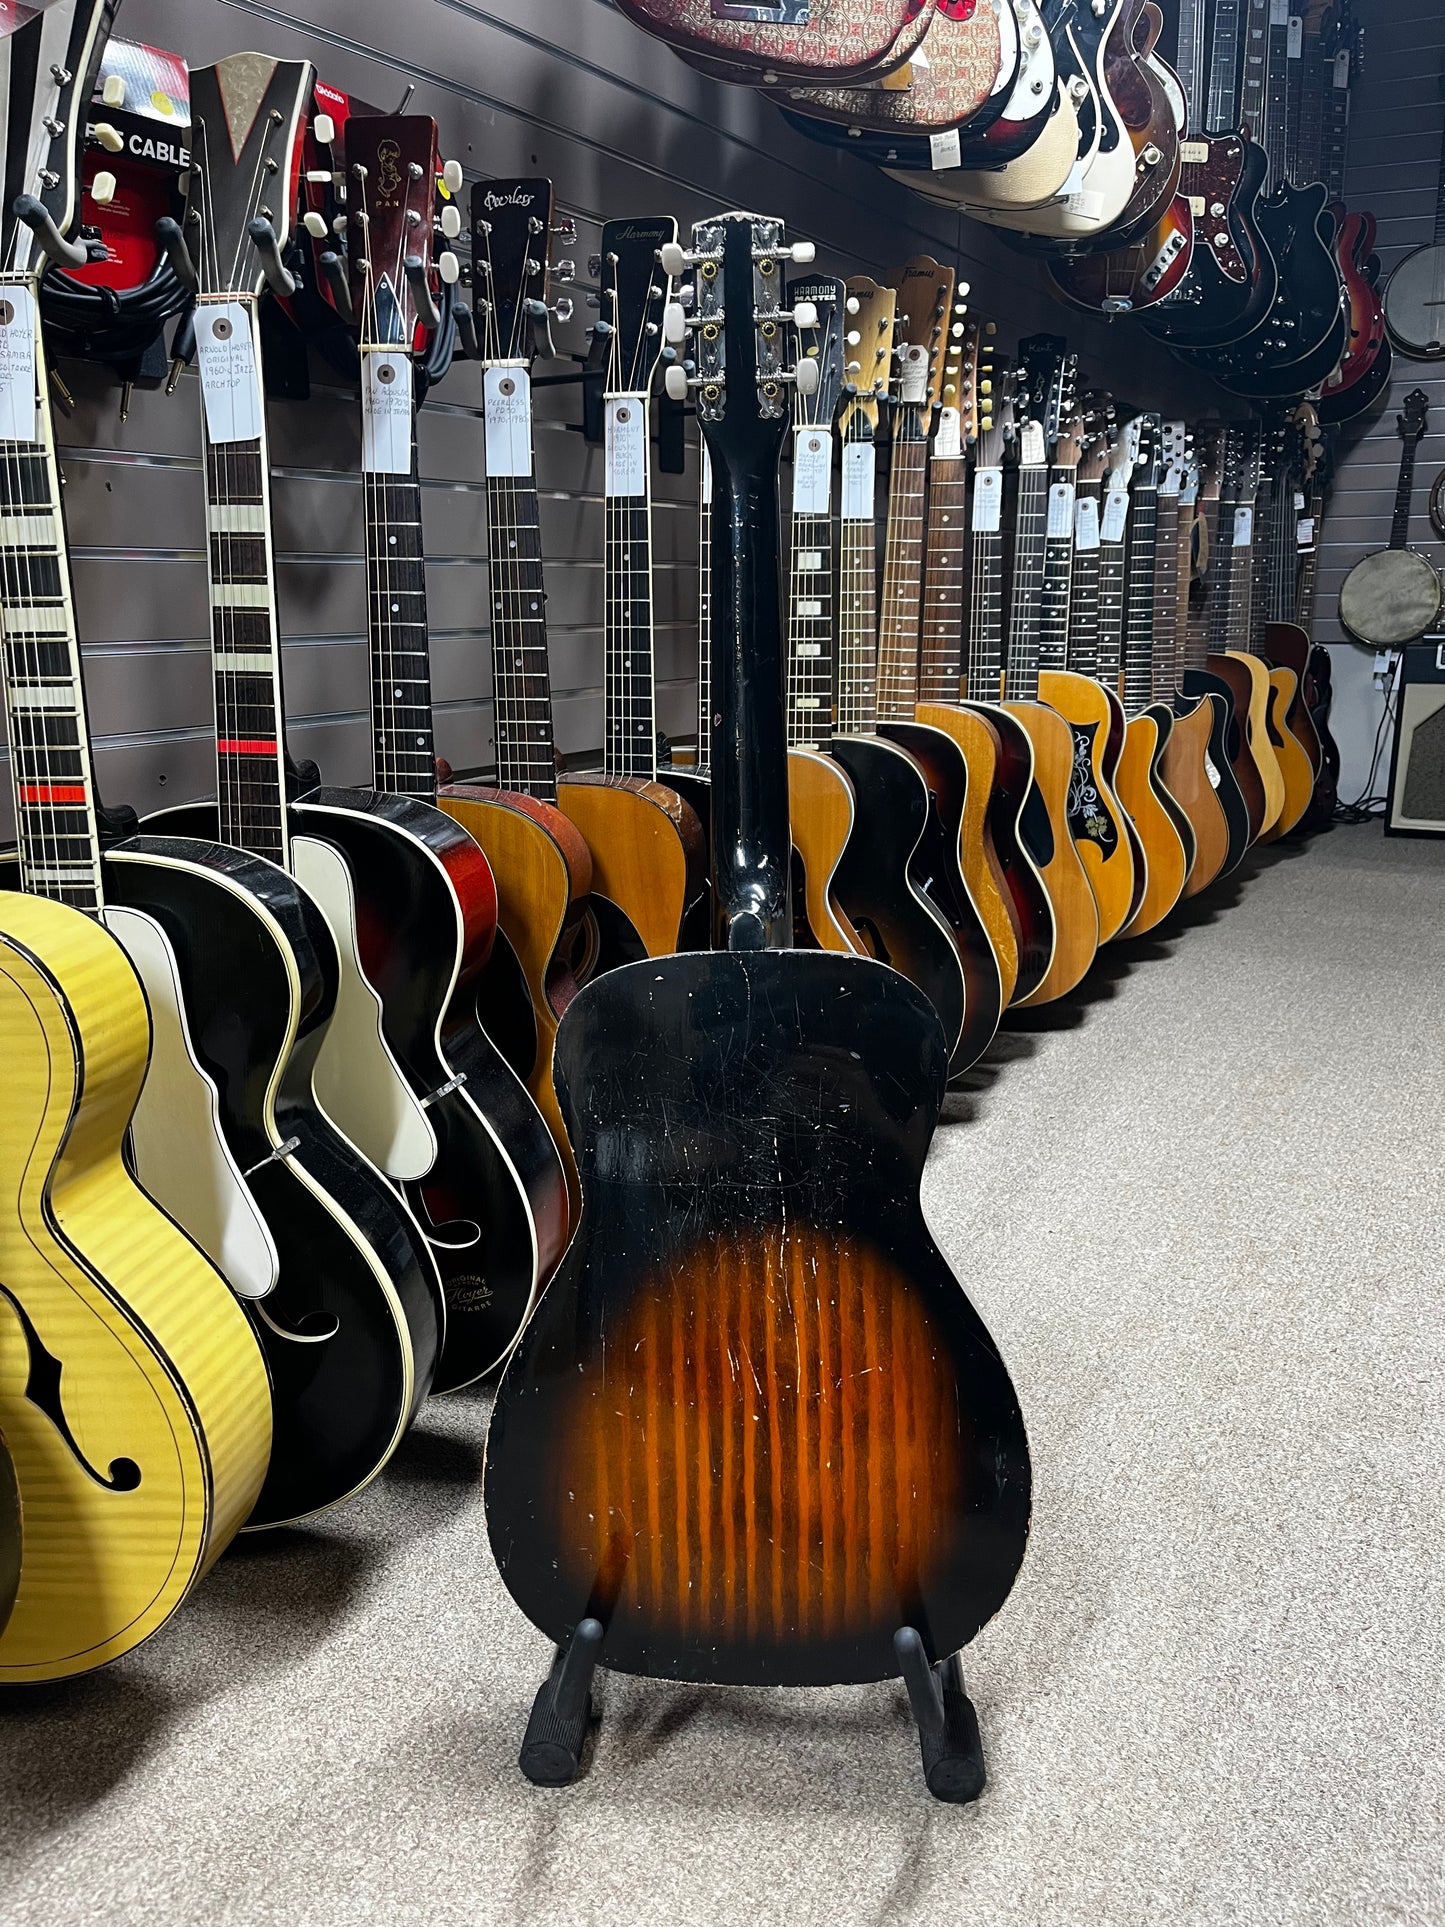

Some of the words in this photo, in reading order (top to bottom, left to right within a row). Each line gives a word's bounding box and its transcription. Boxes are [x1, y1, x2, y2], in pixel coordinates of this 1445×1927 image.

[129, 134, 191, 168] CABLE
[484, 185, 535, 211] Peerless
[615, 225, 665, 241] Harmony
[901, 266, 934, 284] Framus
[794, 285, 836, 295] HARMONY
[200, 345, 228, 354] ARNOLD
[206, 354, 244, 364] ORIGINAL
[234, 363, 254, 375] JAZZ
[446, 1275, 486, 1286] ORIGINAL
